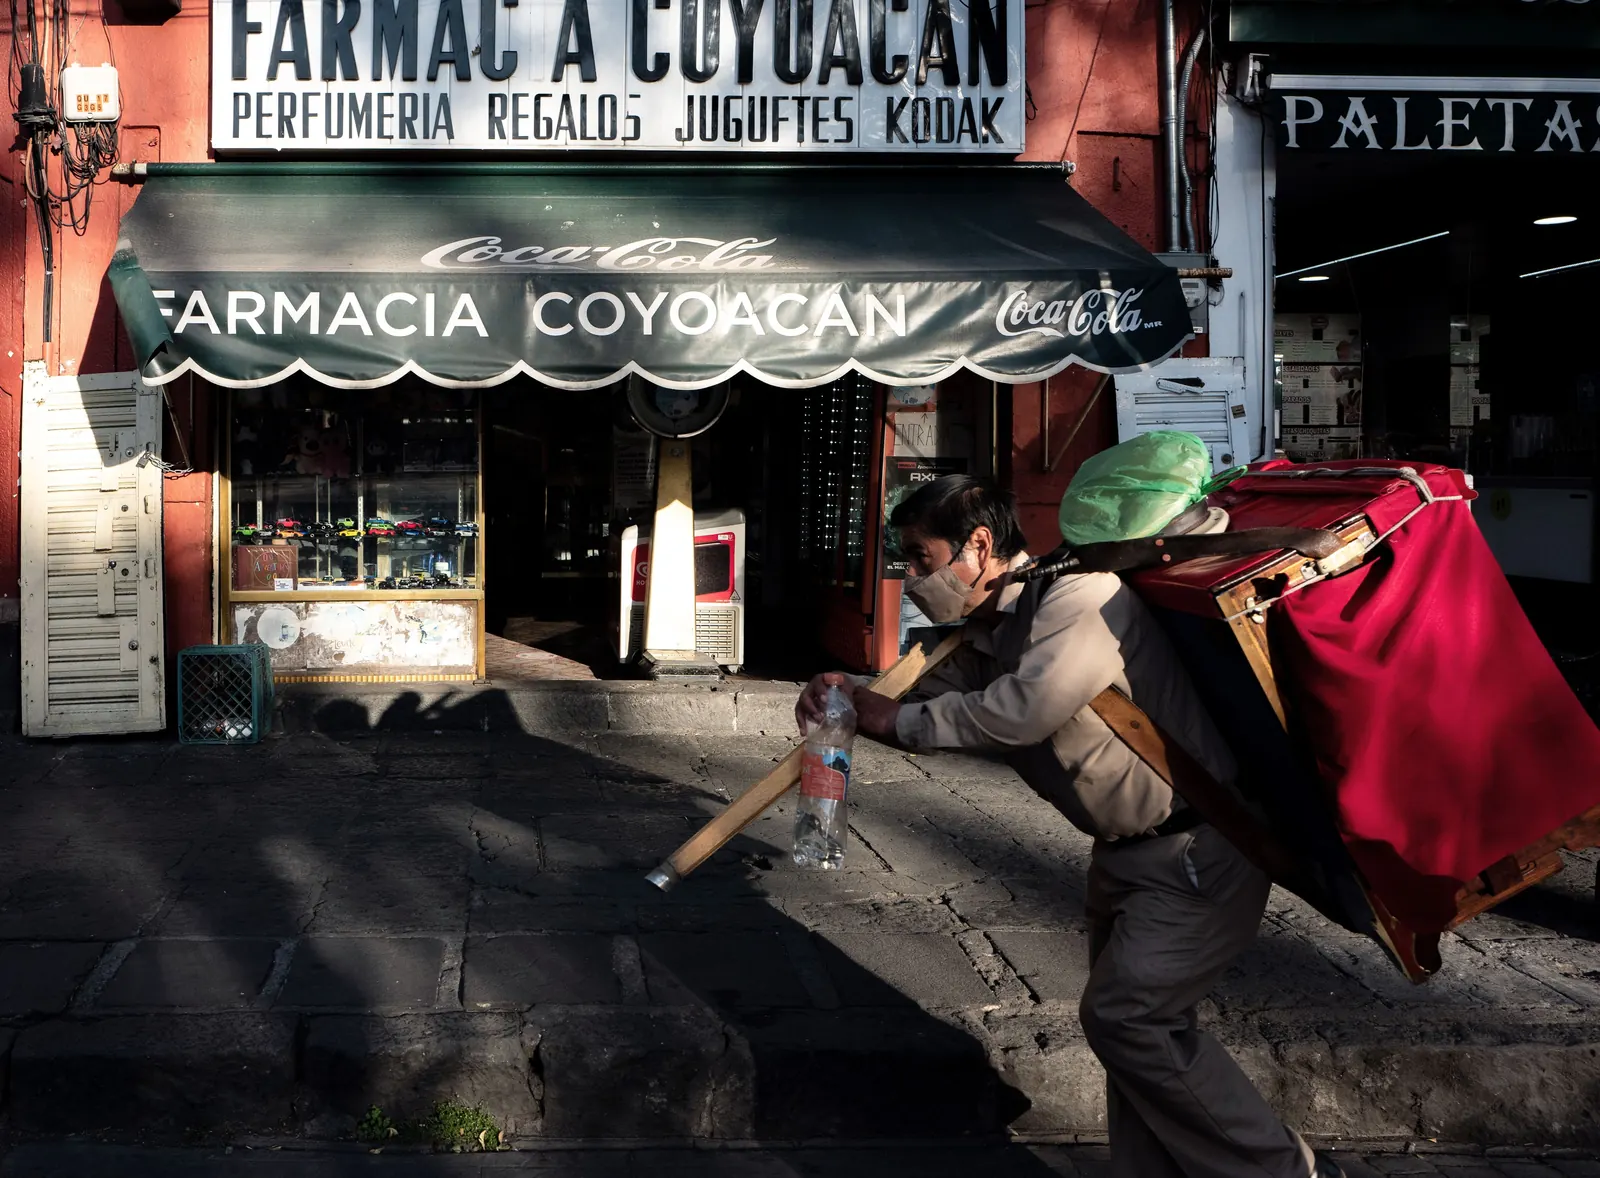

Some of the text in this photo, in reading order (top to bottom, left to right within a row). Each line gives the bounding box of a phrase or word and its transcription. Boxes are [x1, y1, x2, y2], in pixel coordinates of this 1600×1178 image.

[631, 0, 1008, 86] COYOACAN
[232, 91, 455, 140] PERFUMERIA
[886, 96, 1005, 144] KODAK
[1281, 95, 1600, 153] PALETA
[421, 236, 778, 270] Coca-Cola
[533, 291, 906, 337] COYOACAN
[996, 287, 1163, 338] Coca-Cola MR
